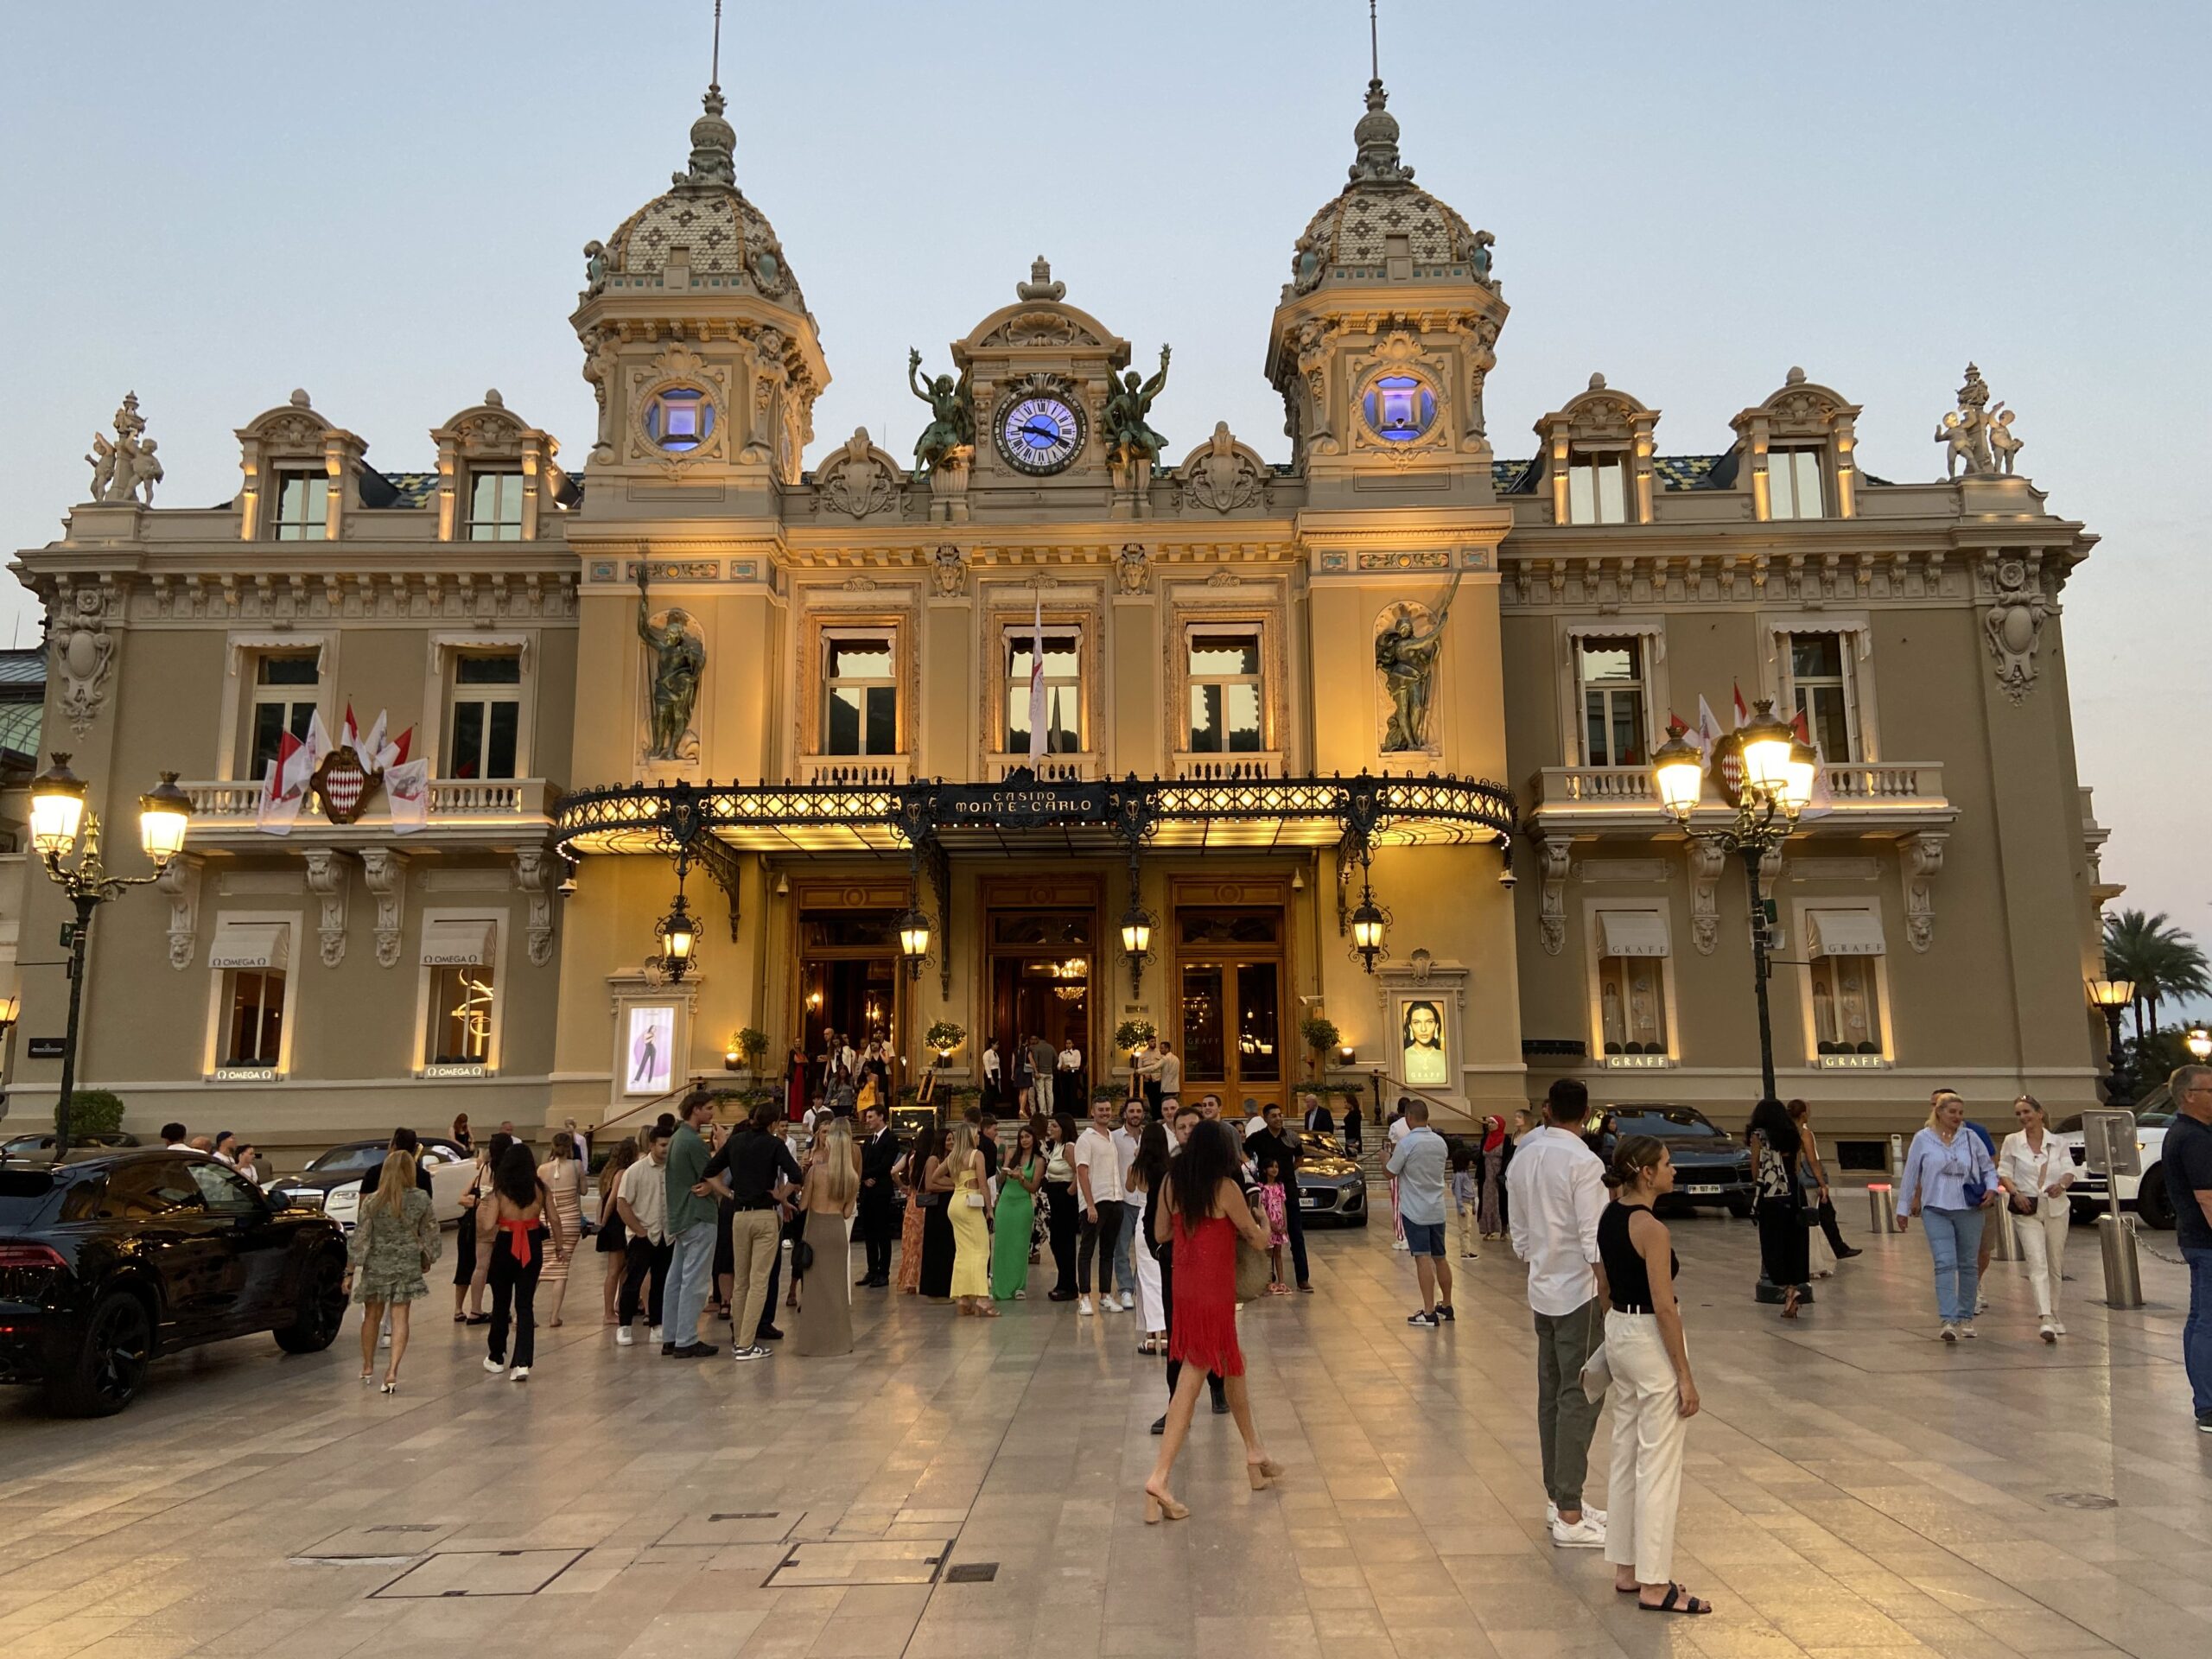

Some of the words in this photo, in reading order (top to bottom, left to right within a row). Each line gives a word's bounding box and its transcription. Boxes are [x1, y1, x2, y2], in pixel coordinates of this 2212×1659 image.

[993, 791, 1056, 802] CASINO
[1612, 945, 1665, 954] GRAFF
[1828, 944, 1882, 953] GRAFF
[434, 955, 467, 963] OMEGA
[1611, 1057, 1664, 1066] GRAFF
[1826, 1057, 1880, 1066] GRAFF
[229, 1071, 260, 1079] OMEGA
[439, 1068, 470, 1076] OMEGA
